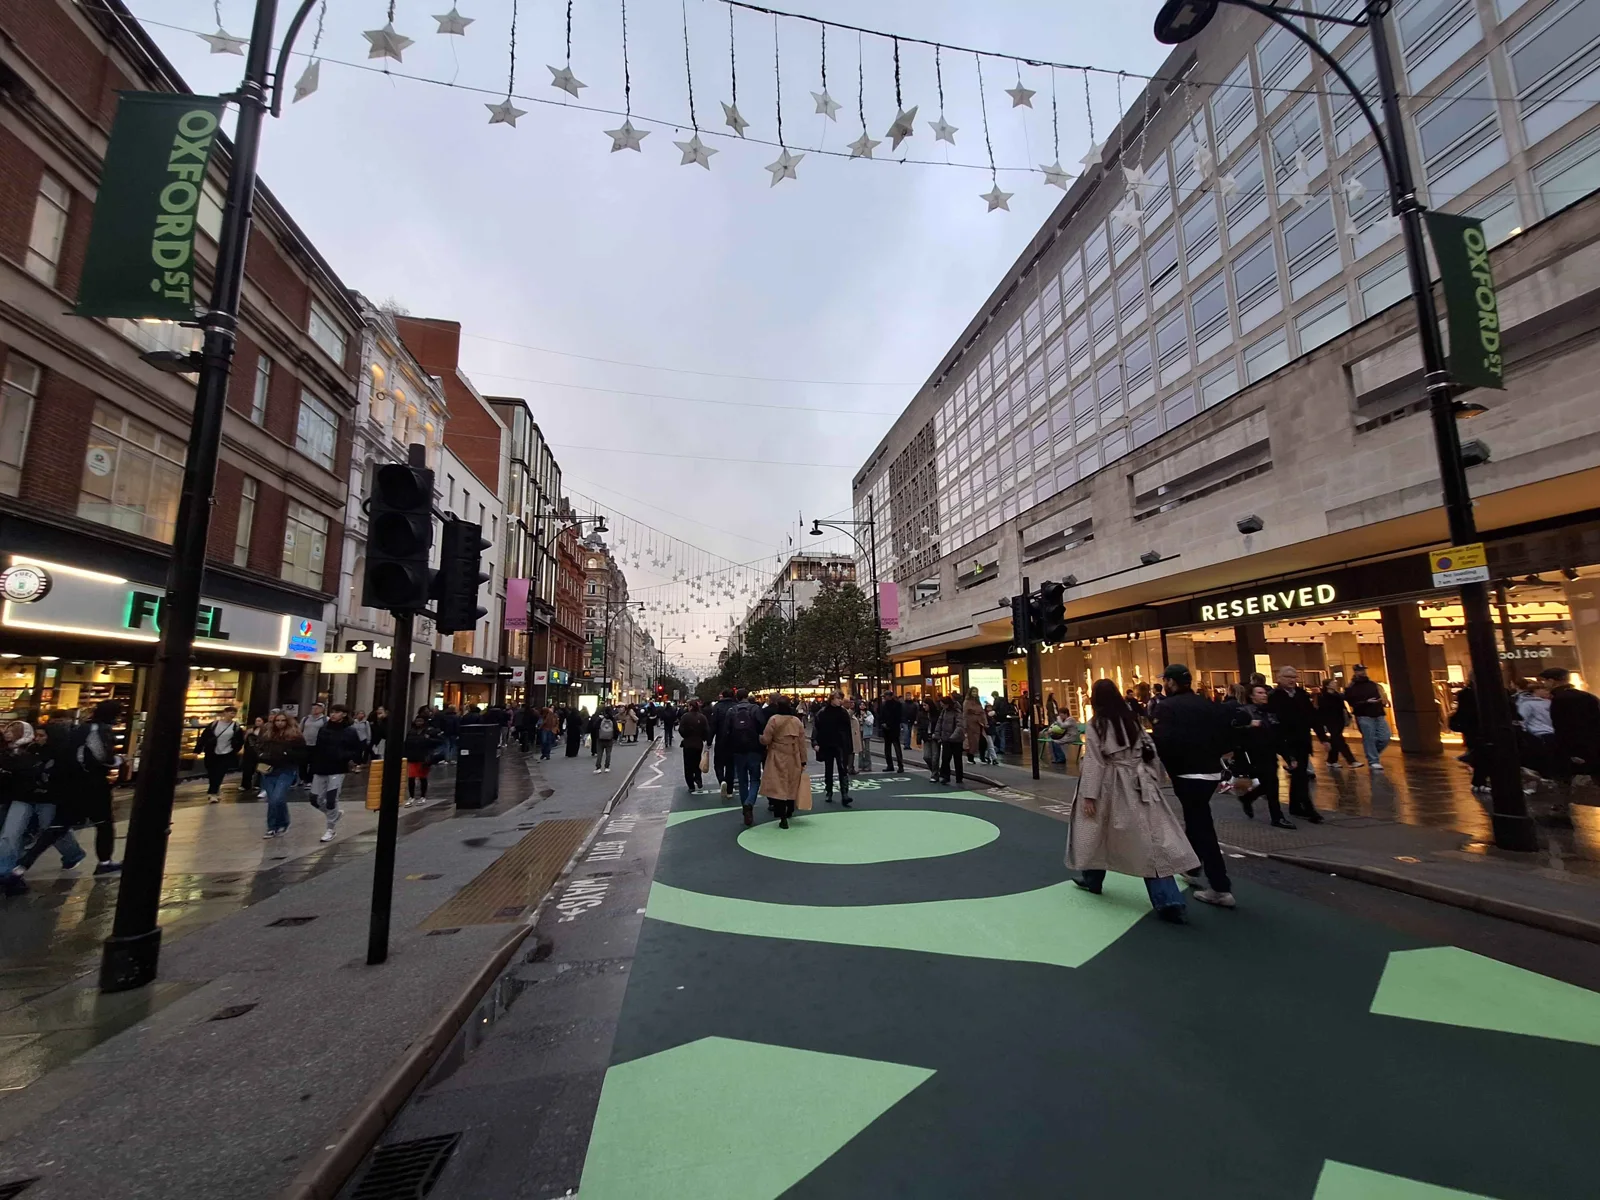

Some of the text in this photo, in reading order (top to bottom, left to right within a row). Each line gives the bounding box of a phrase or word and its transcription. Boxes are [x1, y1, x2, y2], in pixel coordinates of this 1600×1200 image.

[152, 109, 218, 269] OXFORD
[1463, 227, 1500, 352] OXFORD
[15, 571, 33, 579] FUEL
[127, 590, 230, 641] FEL
[1201, 584, 1336, 622] RESERVED
[555, 876, 613, 910] WAYS
